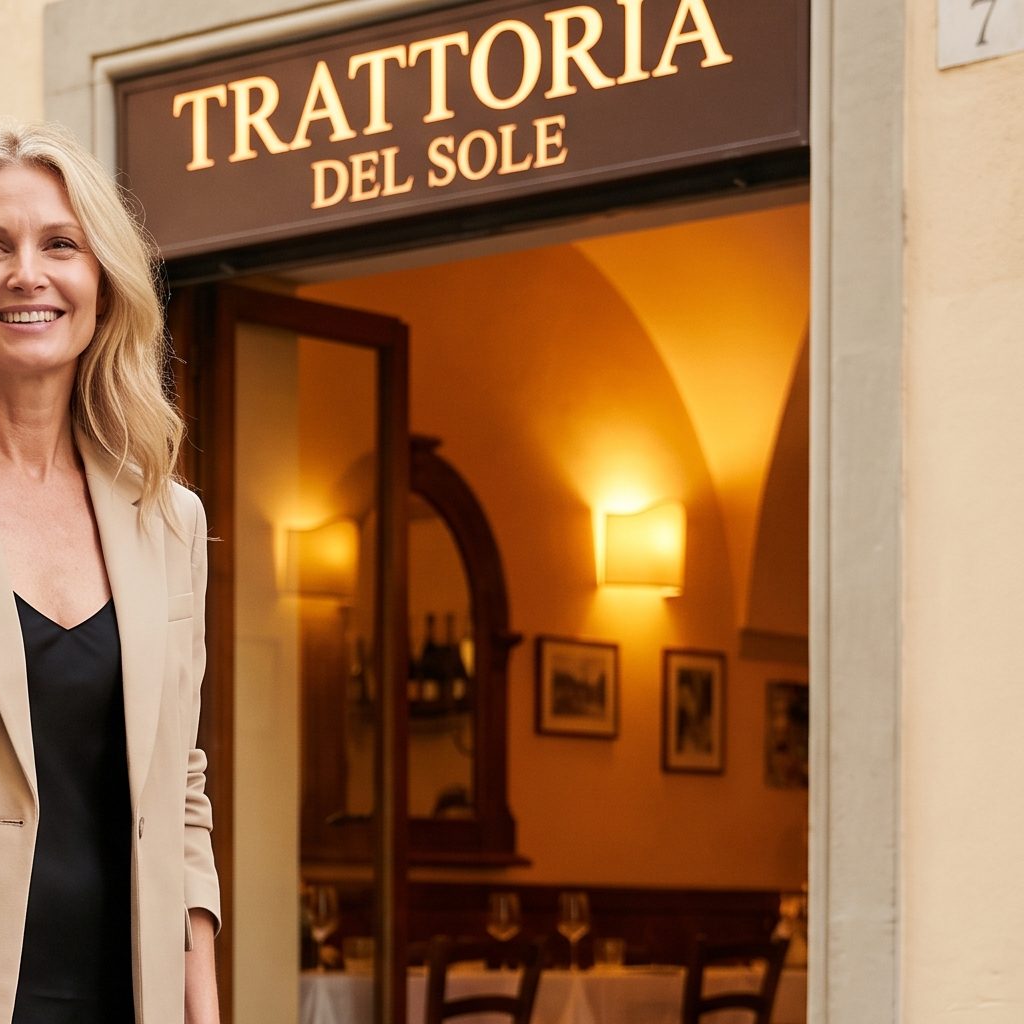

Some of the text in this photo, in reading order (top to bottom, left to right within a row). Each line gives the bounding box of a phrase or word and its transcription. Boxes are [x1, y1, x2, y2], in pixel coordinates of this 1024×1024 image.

[172, 0, 733, 171] TRATTORIA
[311, 114, 568, 209] DEL SOLE
